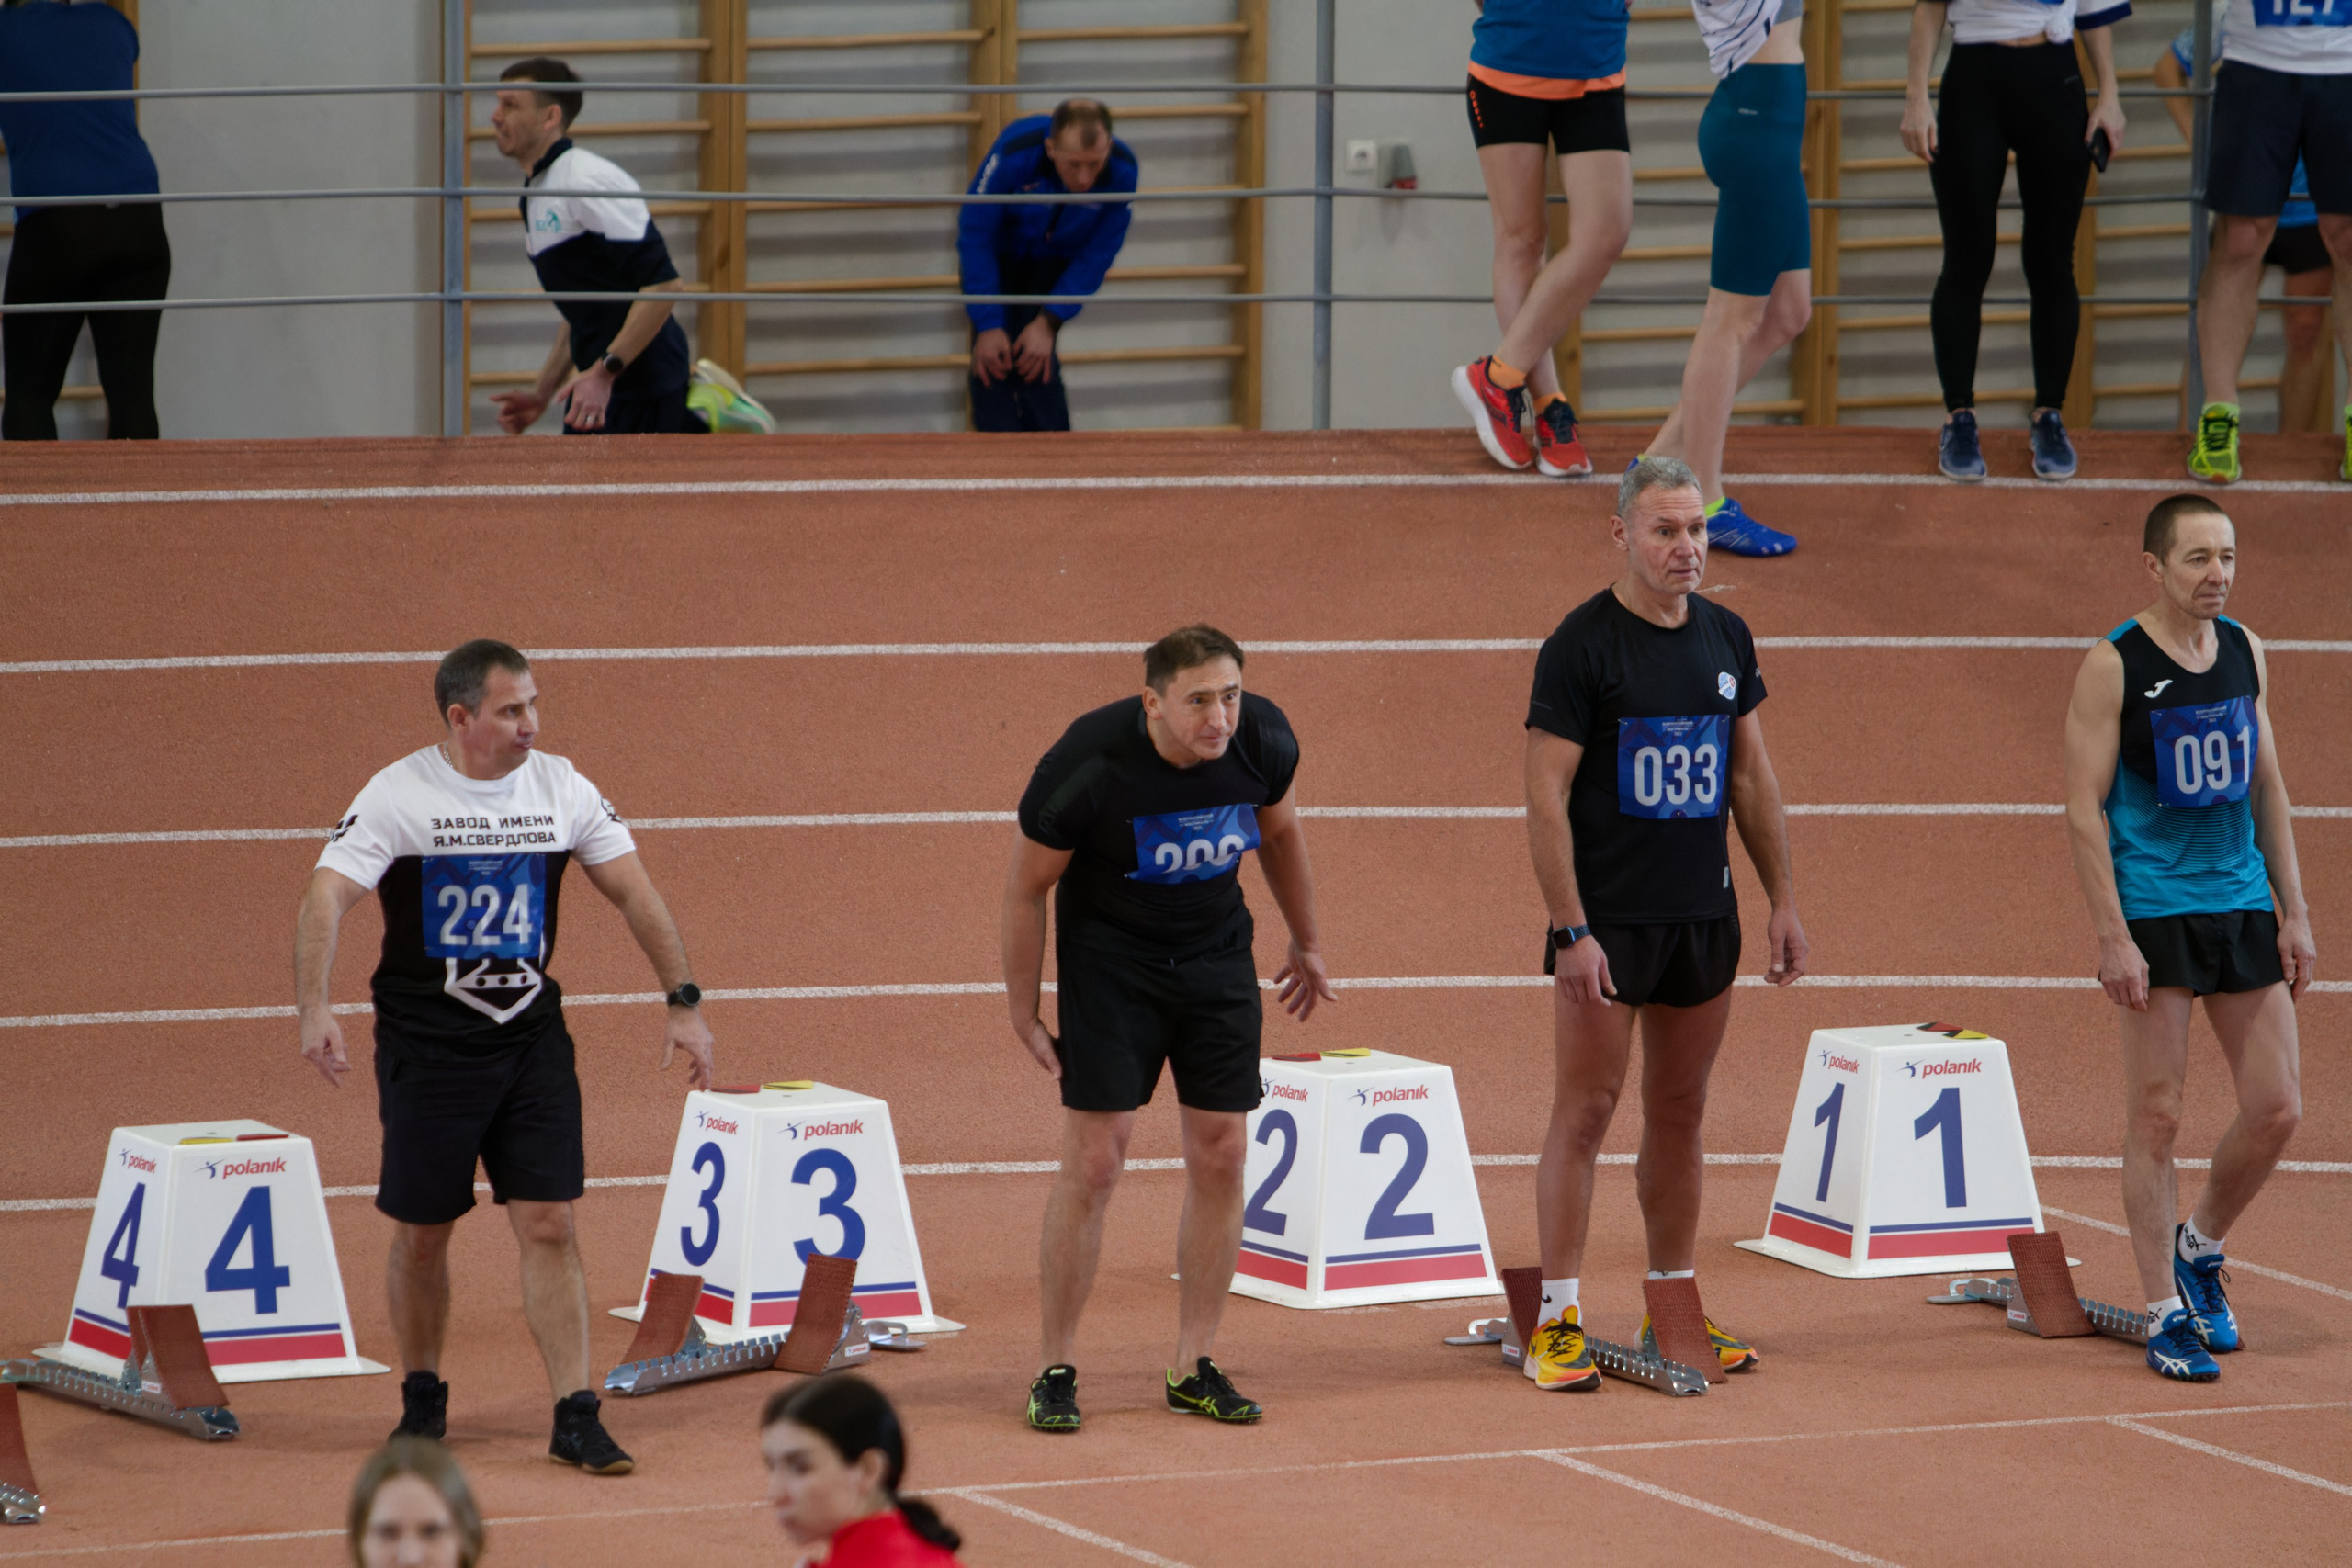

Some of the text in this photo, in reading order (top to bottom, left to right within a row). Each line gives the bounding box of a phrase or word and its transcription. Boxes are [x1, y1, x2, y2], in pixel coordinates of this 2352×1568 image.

[1634, 743, 1718, 806] 033
[2174, 725, 2251, 795] 091
[431, 816, 554, 830] ЗАВОД ИМЕНИ
[433, 832, 557, 848] Я.М.СВЕРДЛОВА
[438, 884, 533, 946] 224
[1272, 1084, 1309, 1102] polanik
[1373, 1085, 1429, 1106] polanik
[1828, 1055, 1860, 1074] polanik
[1922, 1058, 1982, 1079] polanik
[706, 1116, 739, 1135] polanik
[804, 1119, 864, 1140] polanik
[1815, 1082, 1845, 1202] 1
[1913, 1087, 1967, 1208] 1
[128, 1155, 156, 1174] polanik
[222, 1157, 287, 1179] polanik
[1243, 1109, 1297, 1236] 2
[1359, 1112, 1434, 1240] 2
[680, 1141, 725, 1267] 3
[791, 1148, 865, 1266] 3
[100, 1182, 146, 1310] 4
[204, 1185, 291, 1314] 4
